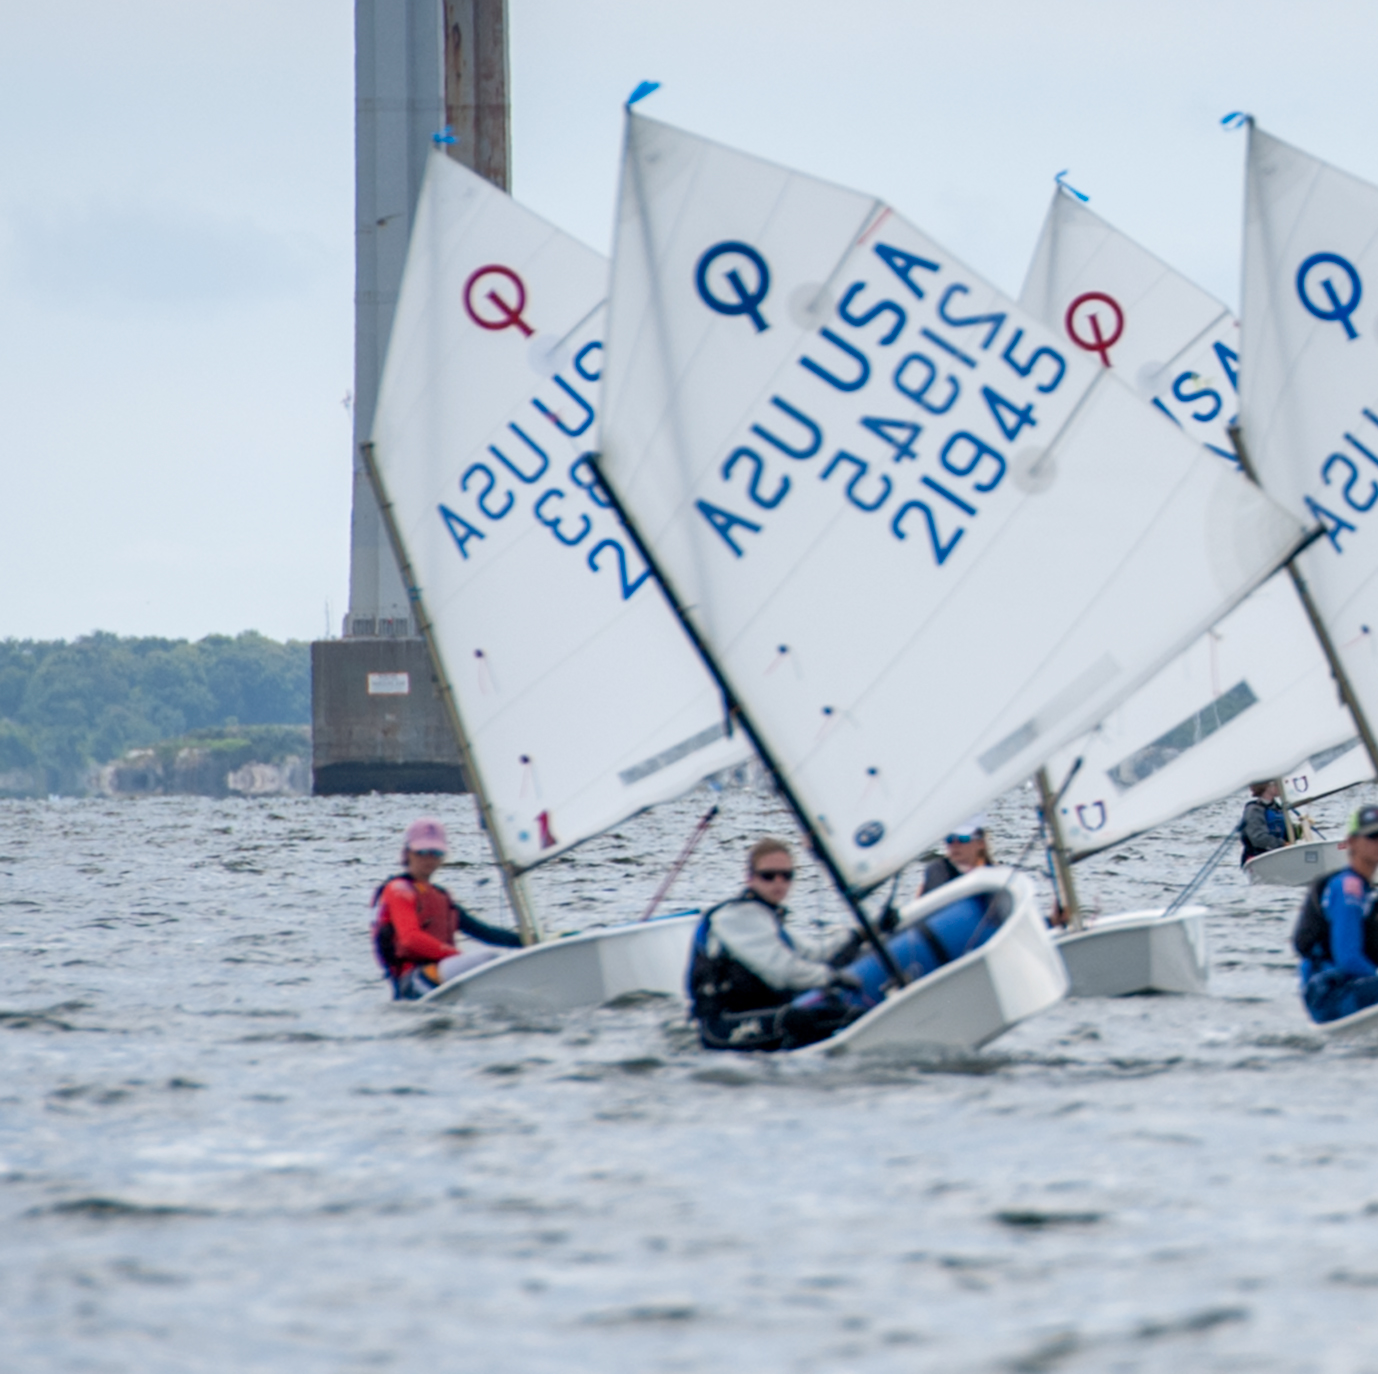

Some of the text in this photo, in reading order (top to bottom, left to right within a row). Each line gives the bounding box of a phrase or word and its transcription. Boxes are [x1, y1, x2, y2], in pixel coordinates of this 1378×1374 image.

[799, 242, 940, 392] USA
[531, 340, 602, 437] US
[892, 328, 1066, 565] 21945
[1152, 341, 1240, 430] SA
